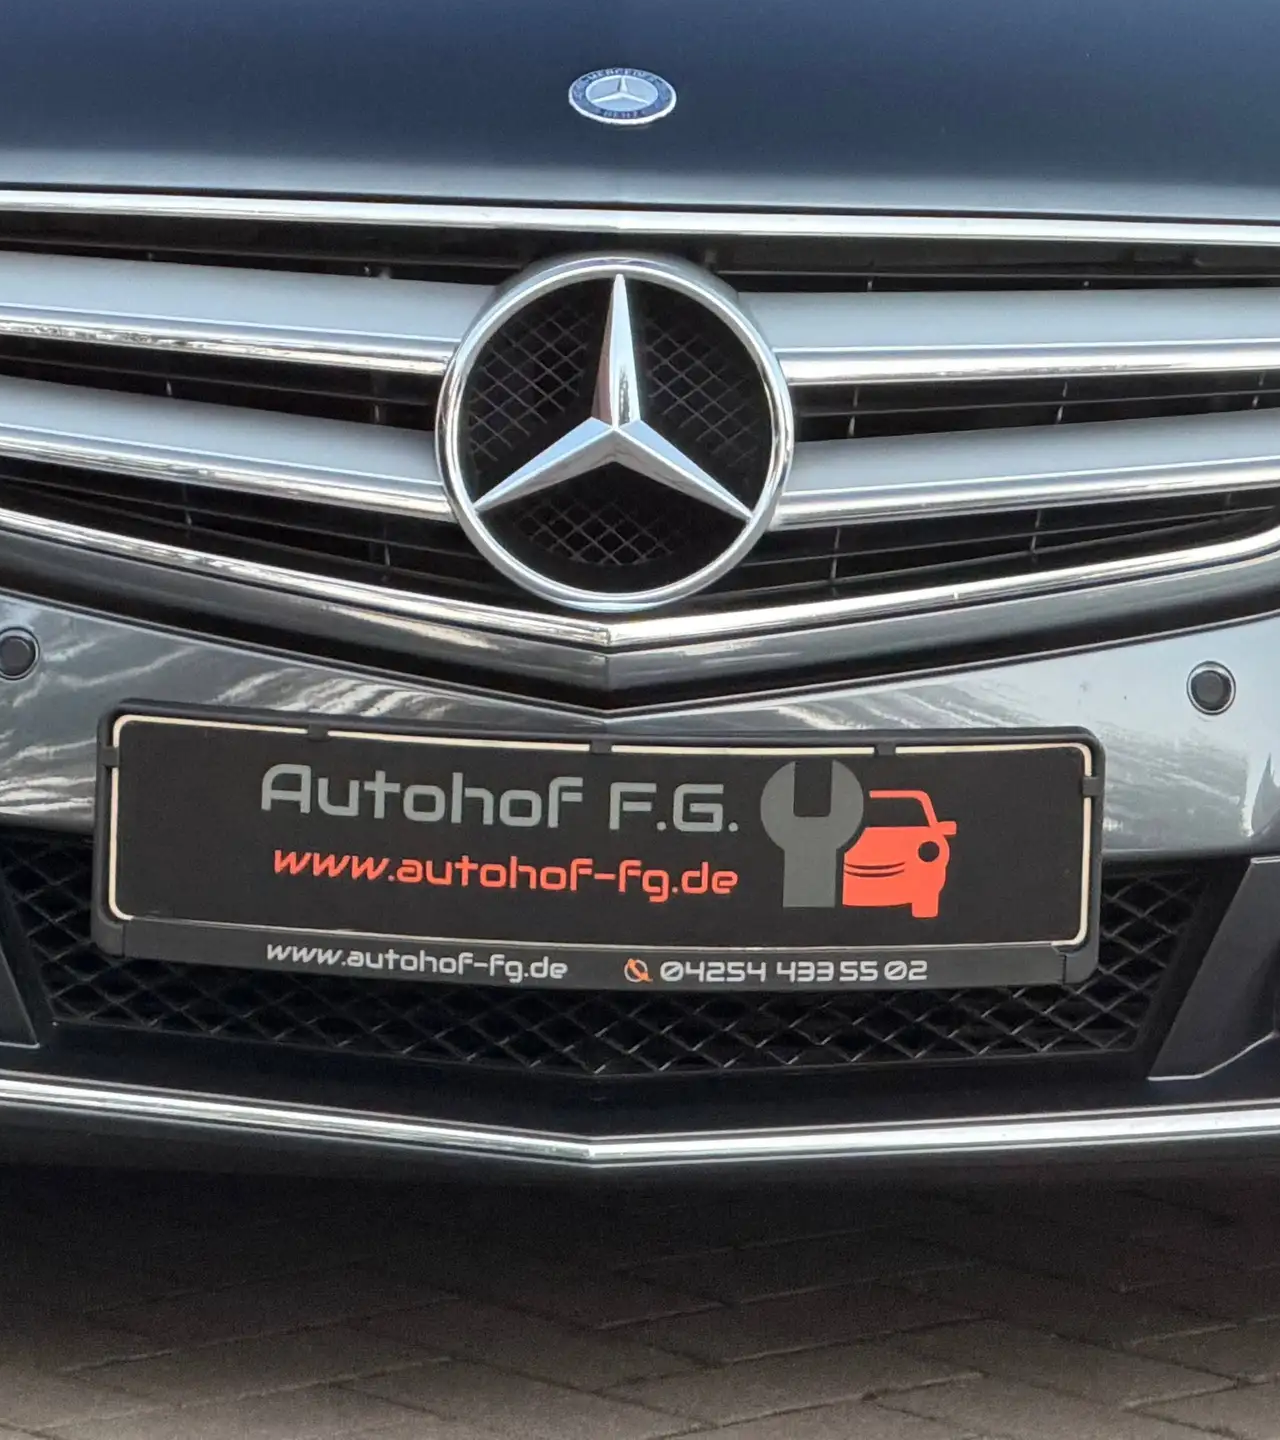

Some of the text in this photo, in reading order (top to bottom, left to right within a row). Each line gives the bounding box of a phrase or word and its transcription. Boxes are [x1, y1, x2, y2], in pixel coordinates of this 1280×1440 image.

[261, 763, 739, 833] Autohof F.G.
[274, 848, 739, 903] www.autohof-fg.de
[266, 944, 568, 984] www.autohof-fg.de
[659, 961, 767, 983] 04254
[883, 960, 928, 982] 02
